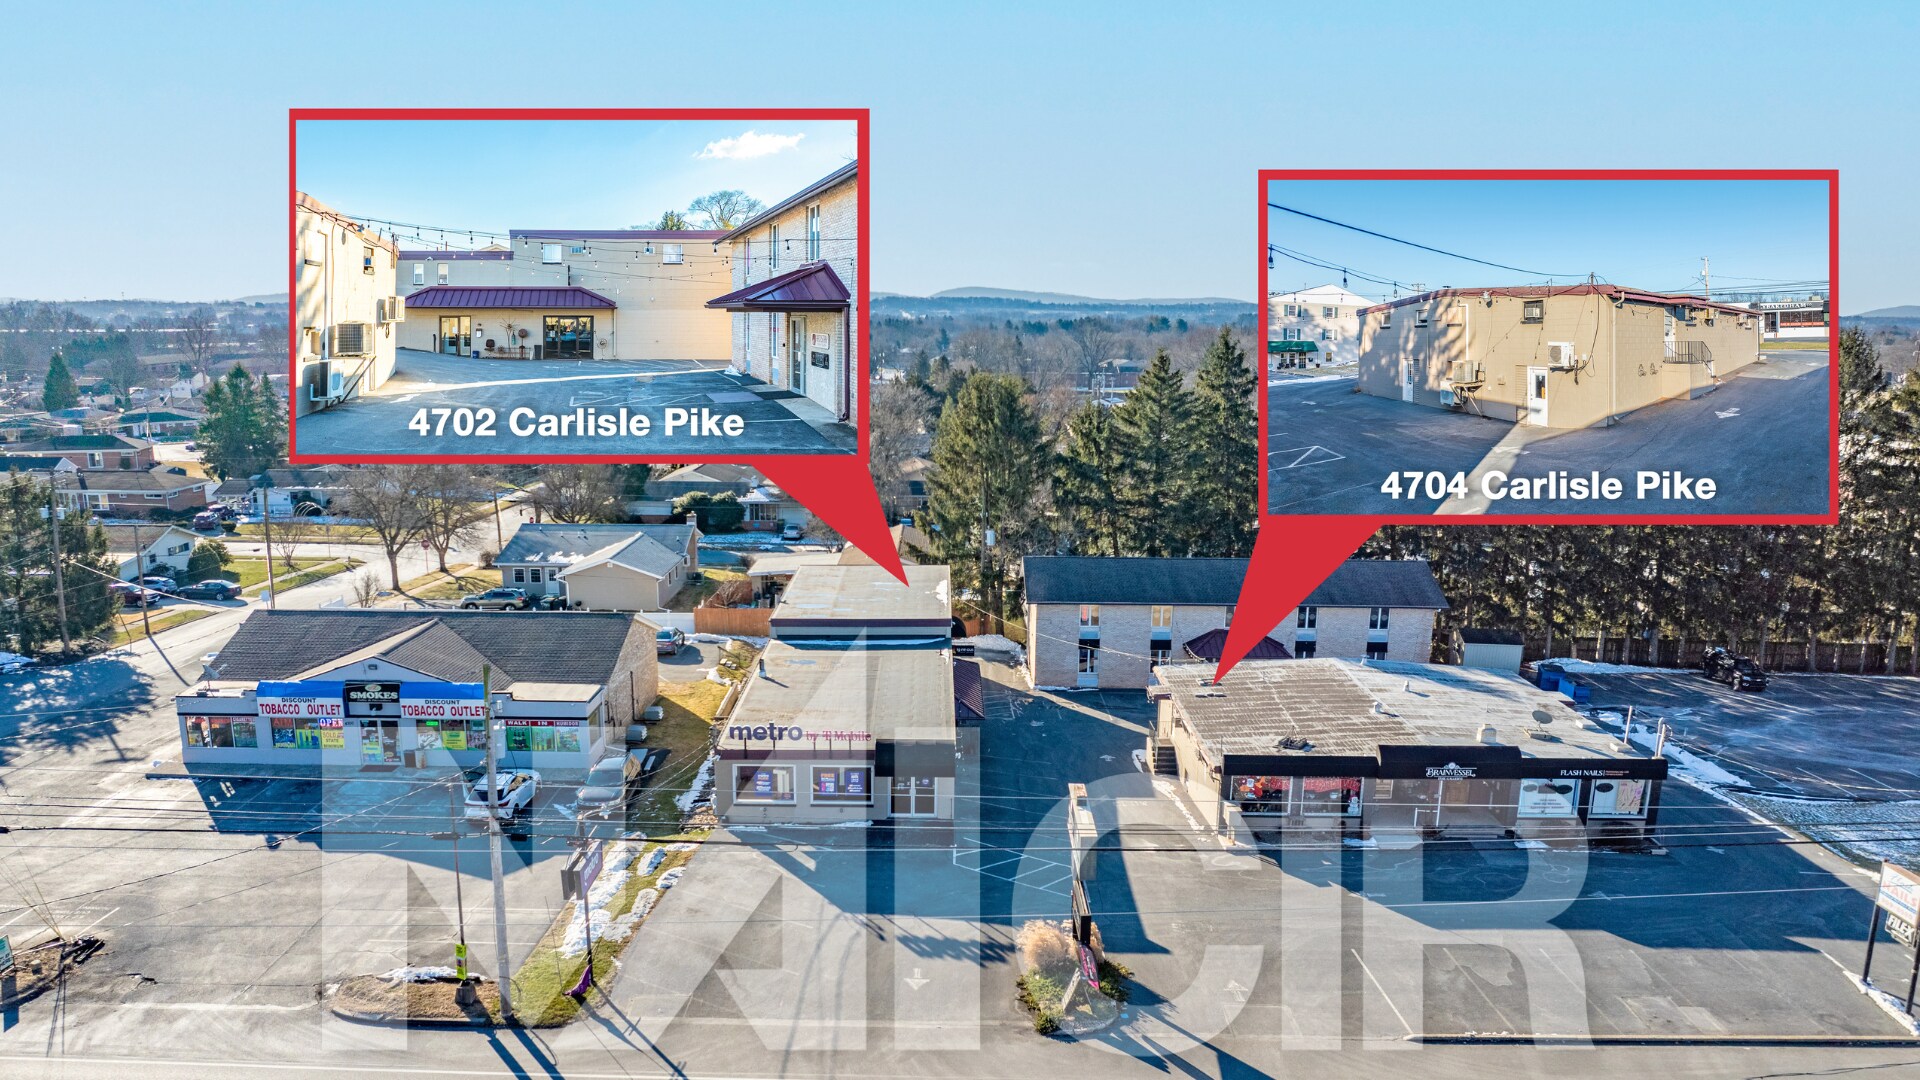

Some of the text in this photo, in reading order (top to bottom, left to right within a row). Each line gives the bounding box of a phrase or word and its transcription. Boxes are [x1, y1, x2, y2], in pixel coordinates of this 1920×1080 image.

[260, 703, 341, 716] TOBACCO OUTLET
[401, 705, 486, 717] TOBACCO OUTLET
[320, 718, 344, 727] OPEN
[729, 722, 803, 741] metro
[806, 731, 819, 742] by
